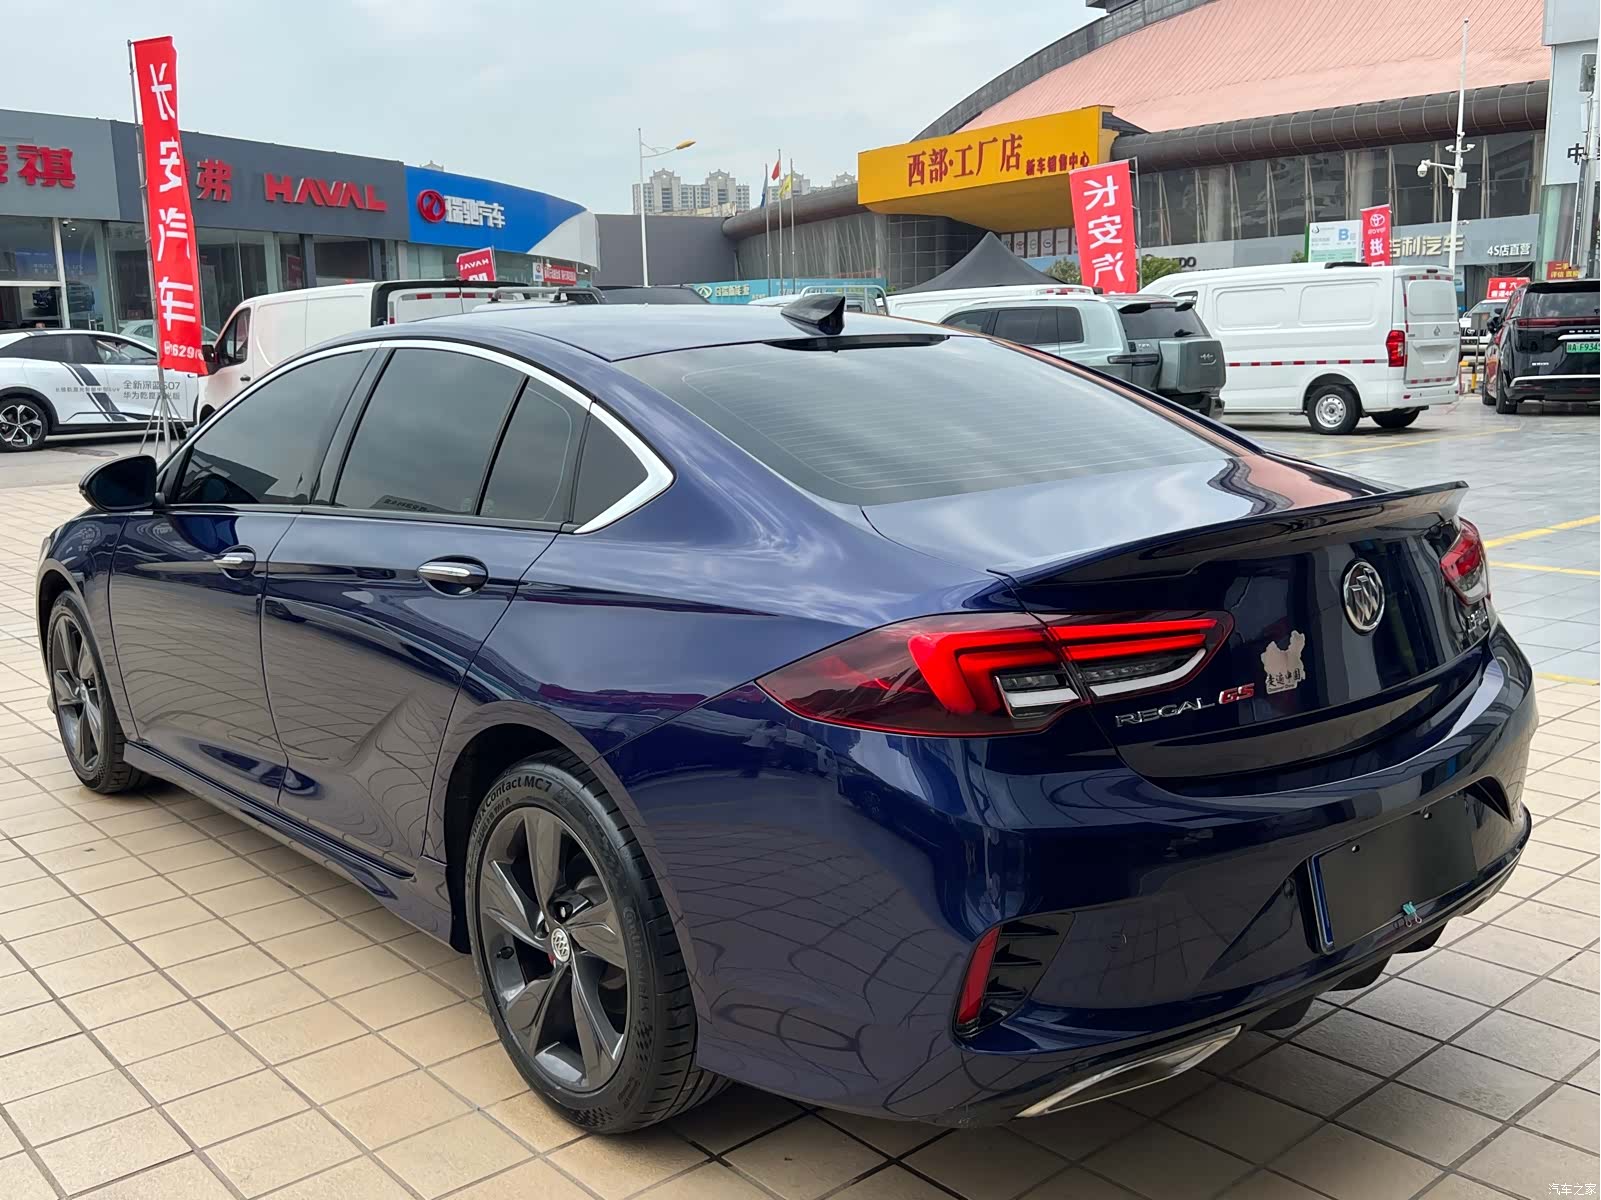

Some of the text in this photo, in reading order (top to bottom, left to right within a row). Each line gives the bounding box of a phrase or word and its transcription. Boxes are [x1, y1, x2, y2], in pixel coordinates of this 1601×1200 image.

[1026, 151, 1090, 176] 新车销售中心
[150, 62, 197, 331] 长安汽车
[264, 172, 387, 212] HAVAL
[444, 194, 506, 228] 瑞驰汽车
[1388, 234, 1465, 258] 吉利汽车
[1487, 243, 1531, 258] 4S店直营
[1115, 683, 1255, 728] REGAL GS
[524, 775, 553, 793] MC7
